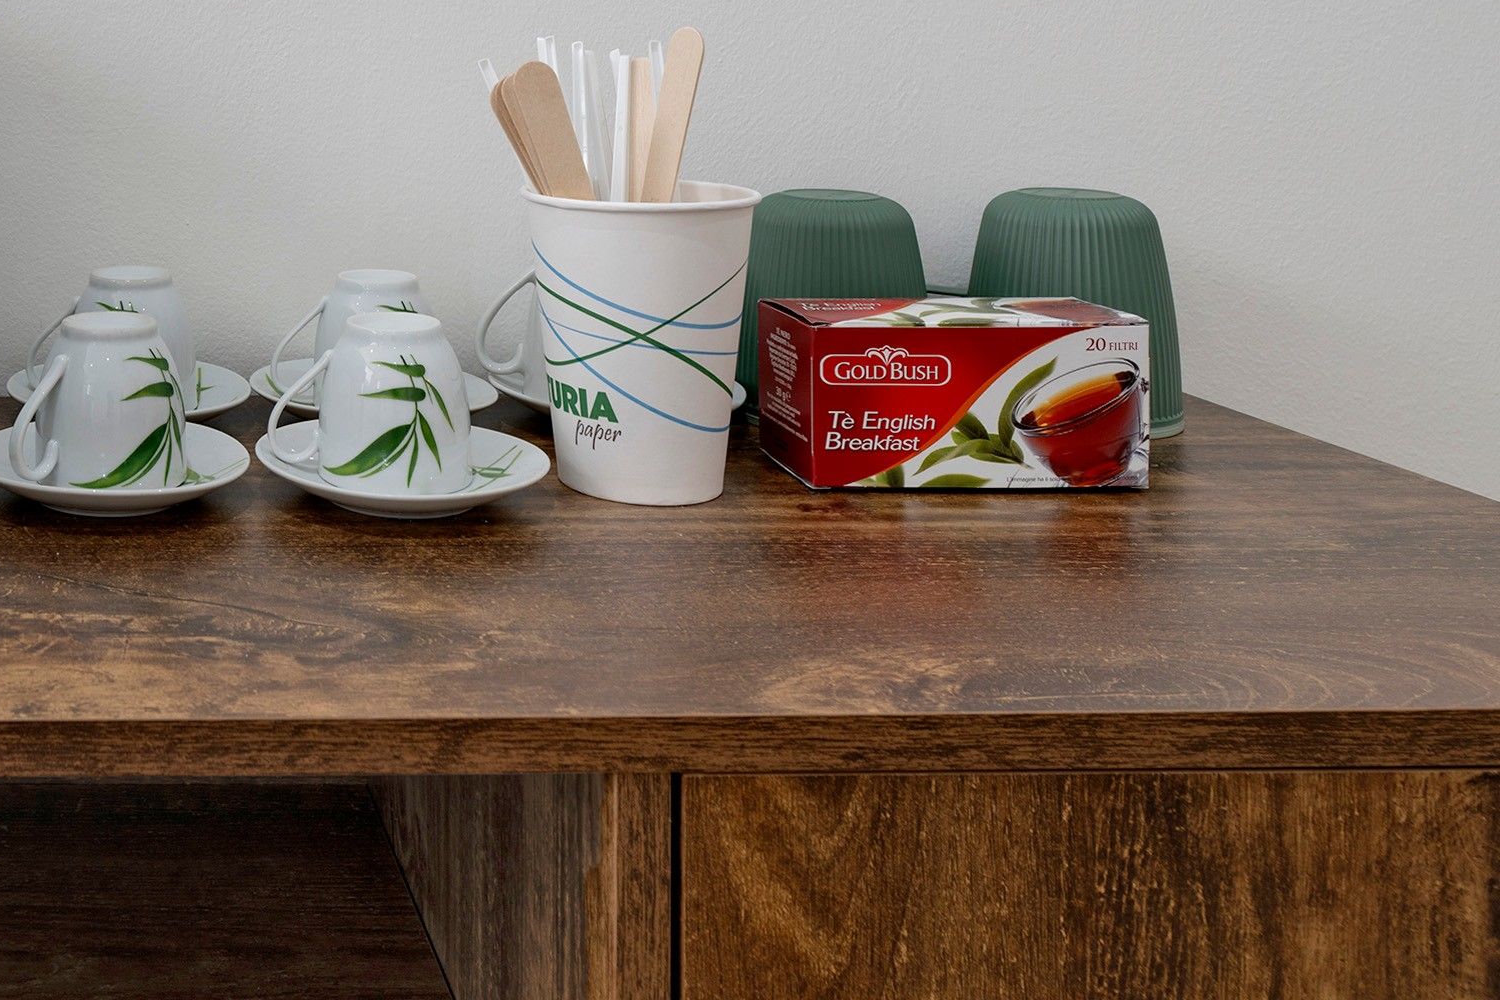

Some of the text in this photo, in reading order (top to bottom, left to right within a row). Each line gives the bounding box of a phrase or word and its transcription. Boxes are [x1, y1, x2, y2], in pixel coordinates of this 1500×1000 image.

[1086, 337, 1139, 352] 20 FILTRI
[834, 361, 939, 380] GOLD BUSH
[828, 410, 855, 430] Tè
[862, 411, 937, 434] English
[575, 419, 622, 450] paper
[825, 431, 920, 451] Breakfast
